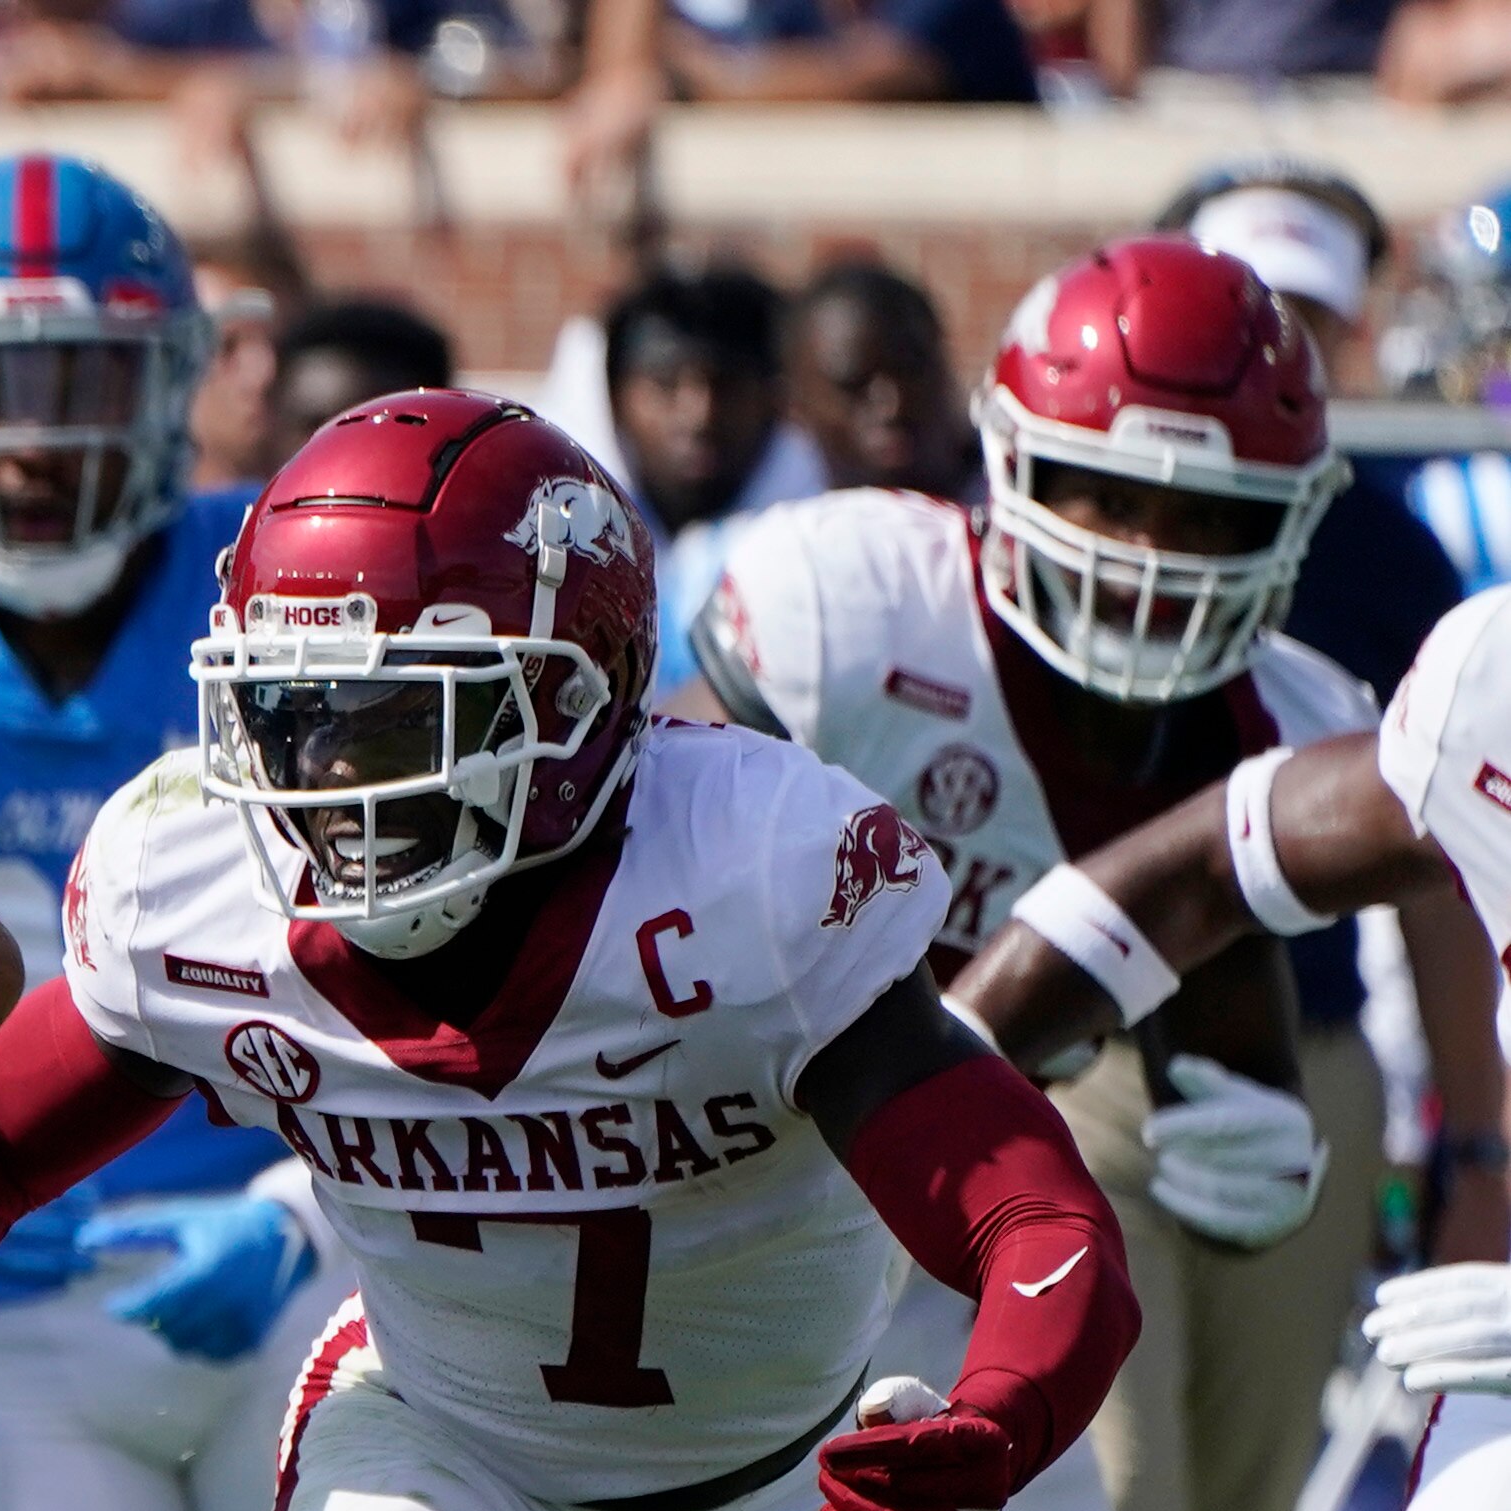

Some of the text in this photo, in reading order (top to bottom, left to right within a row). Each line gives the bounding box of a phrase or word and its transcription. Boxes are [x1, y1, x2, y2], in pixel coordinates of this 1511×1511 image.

[284, 605, 341, 626] HOGS
[180, 965, 261, 992] EQUALITY
[635, 908, 715, 1019] C
[230, 1026, 312, 1099] SEC
[277, 1092, 777, 1192] ARKANSAS
[406, 1204, 676, 1409] 7
